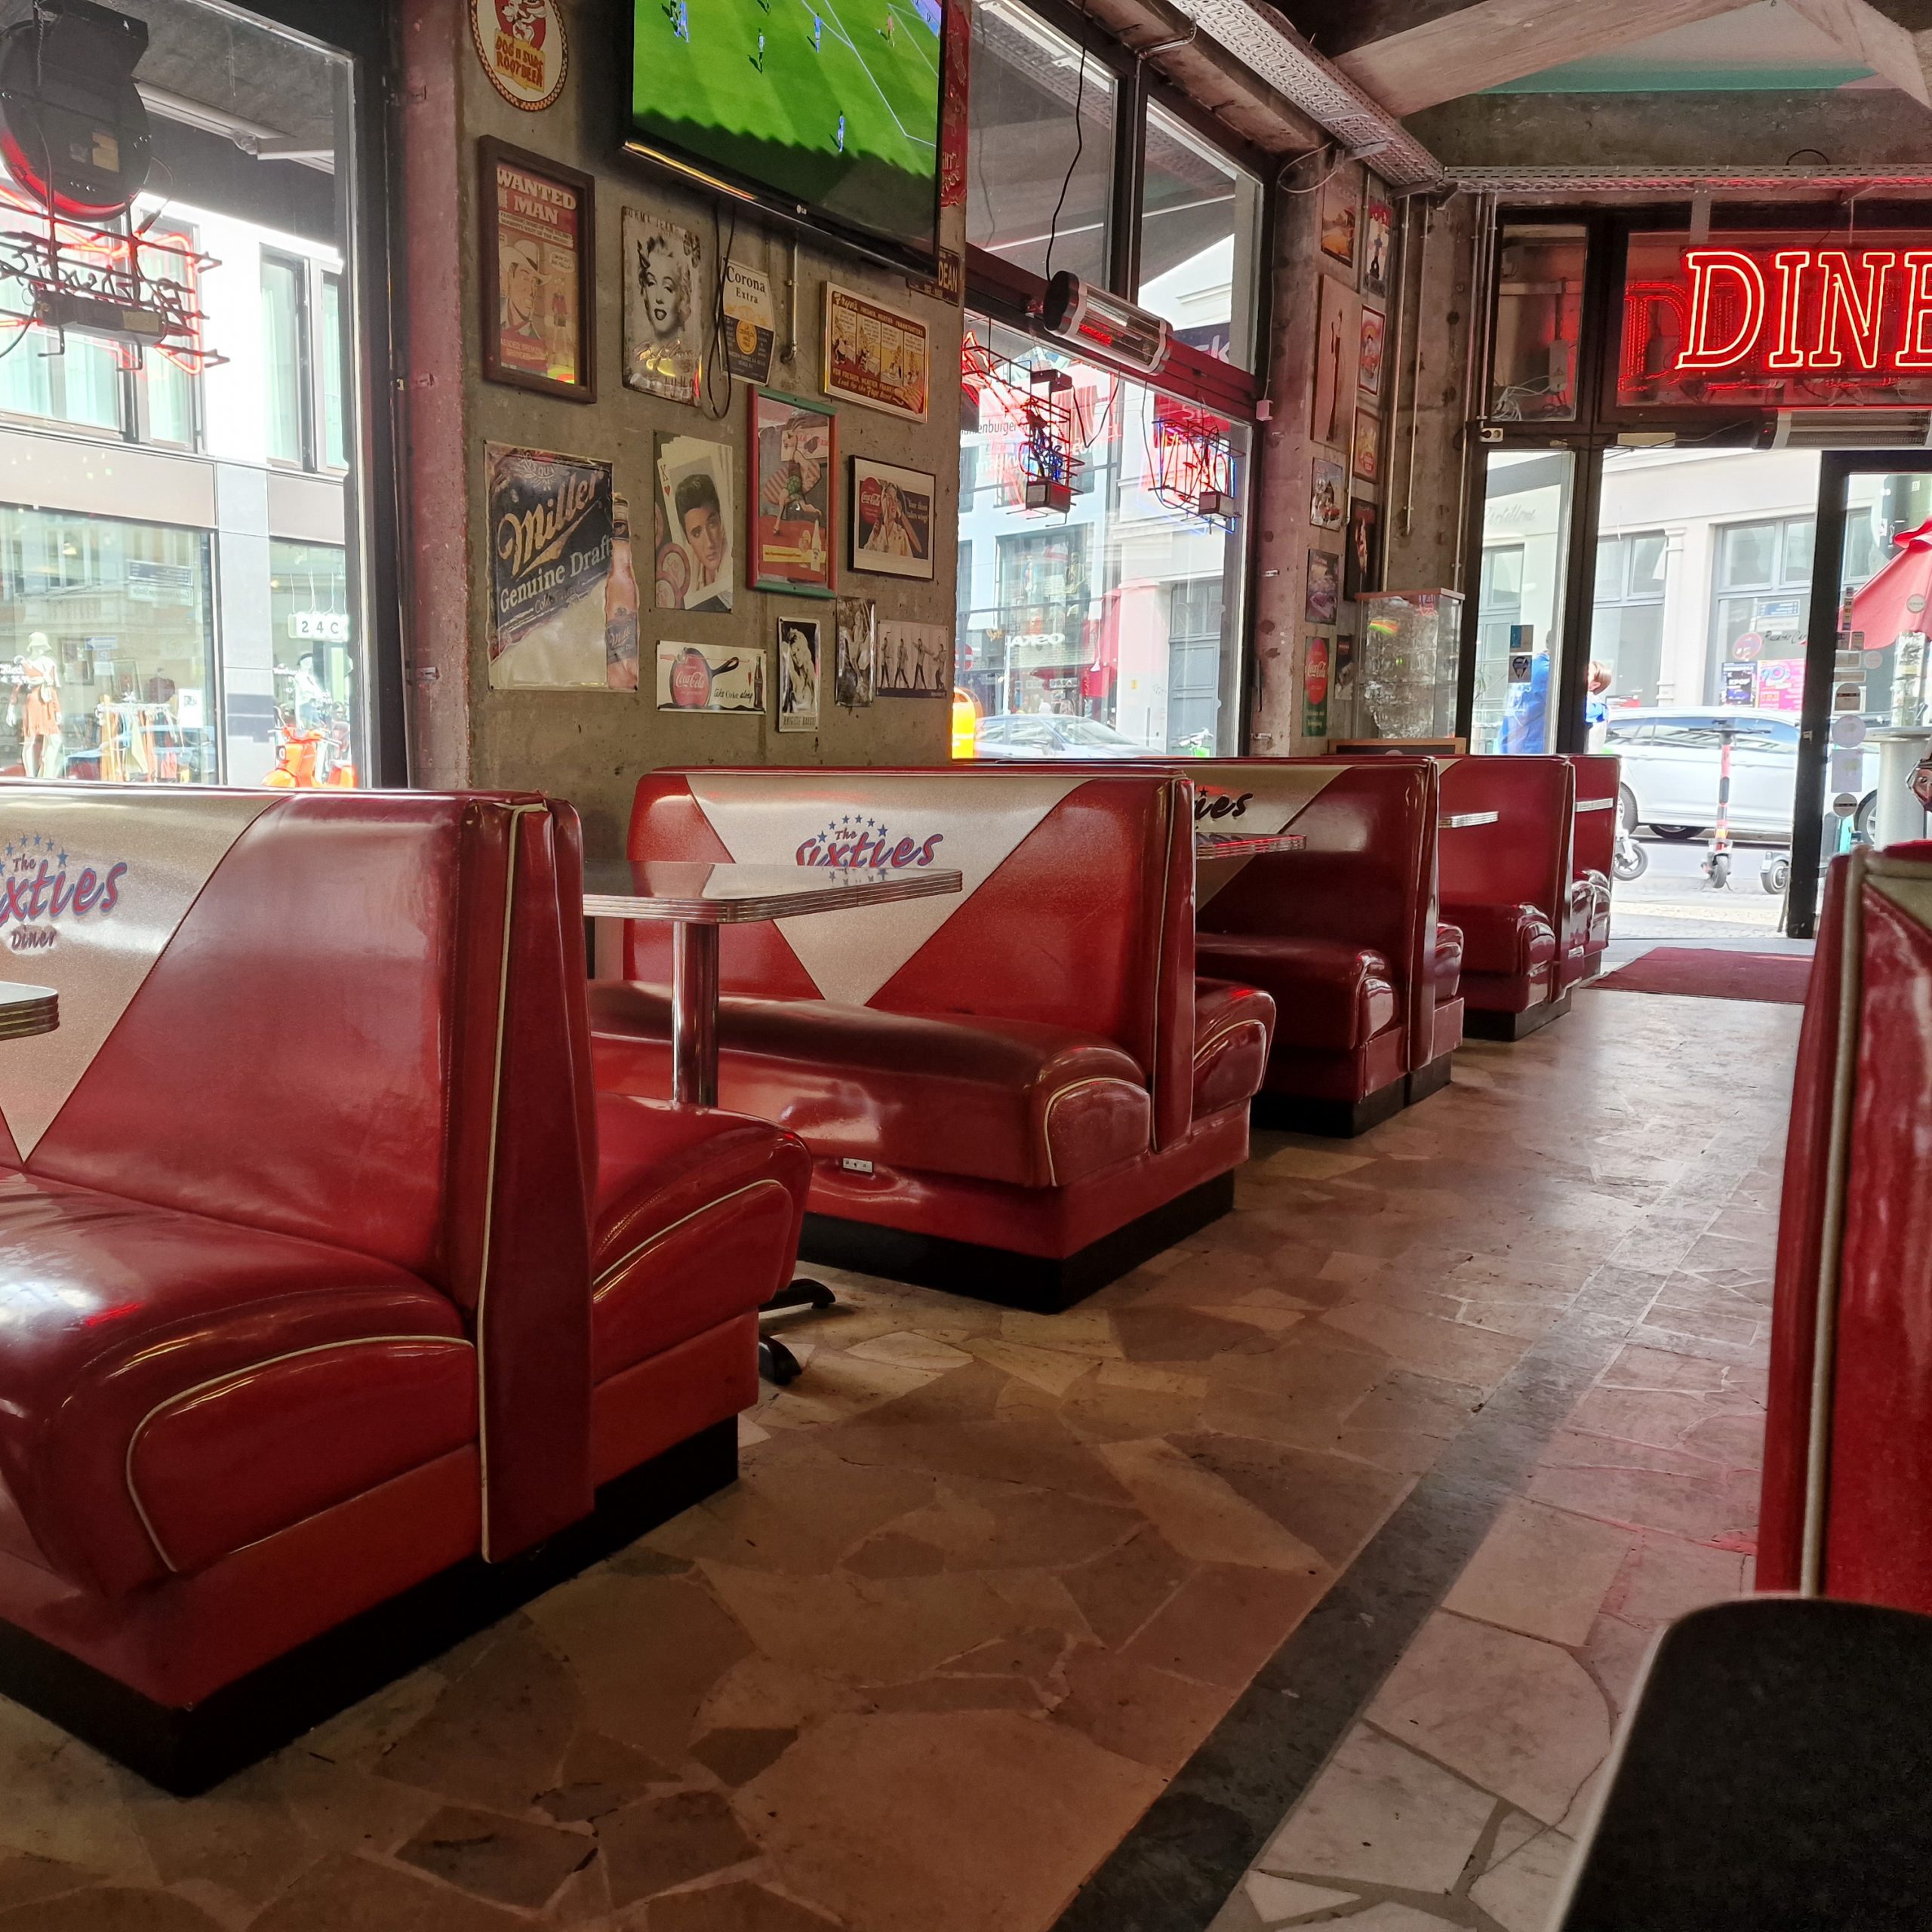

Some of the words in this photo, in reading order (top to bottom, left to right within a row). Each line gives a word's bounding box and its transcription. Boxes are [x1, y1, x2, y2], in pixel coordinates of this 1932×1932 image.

[497, 167, 577, 211] WANTED
[514, 195, 558, 225] MAN
[726, 265, 765, 294] Corona
[938, 260, 958, 294] DEAN
[736, 287, 758, 304] Extra
[1675, 250, 1932, 370] DINE
[497, 470, 601, 576] Miller
[569, 534, 613, 578] Draft
[500, 565, 566, 613] Genuine
[835, 827, 857, 841] The
[13, 853, 36, 872] The
[0, 860, 128, 928] xties
[11, 924, 57, 951] Diner
